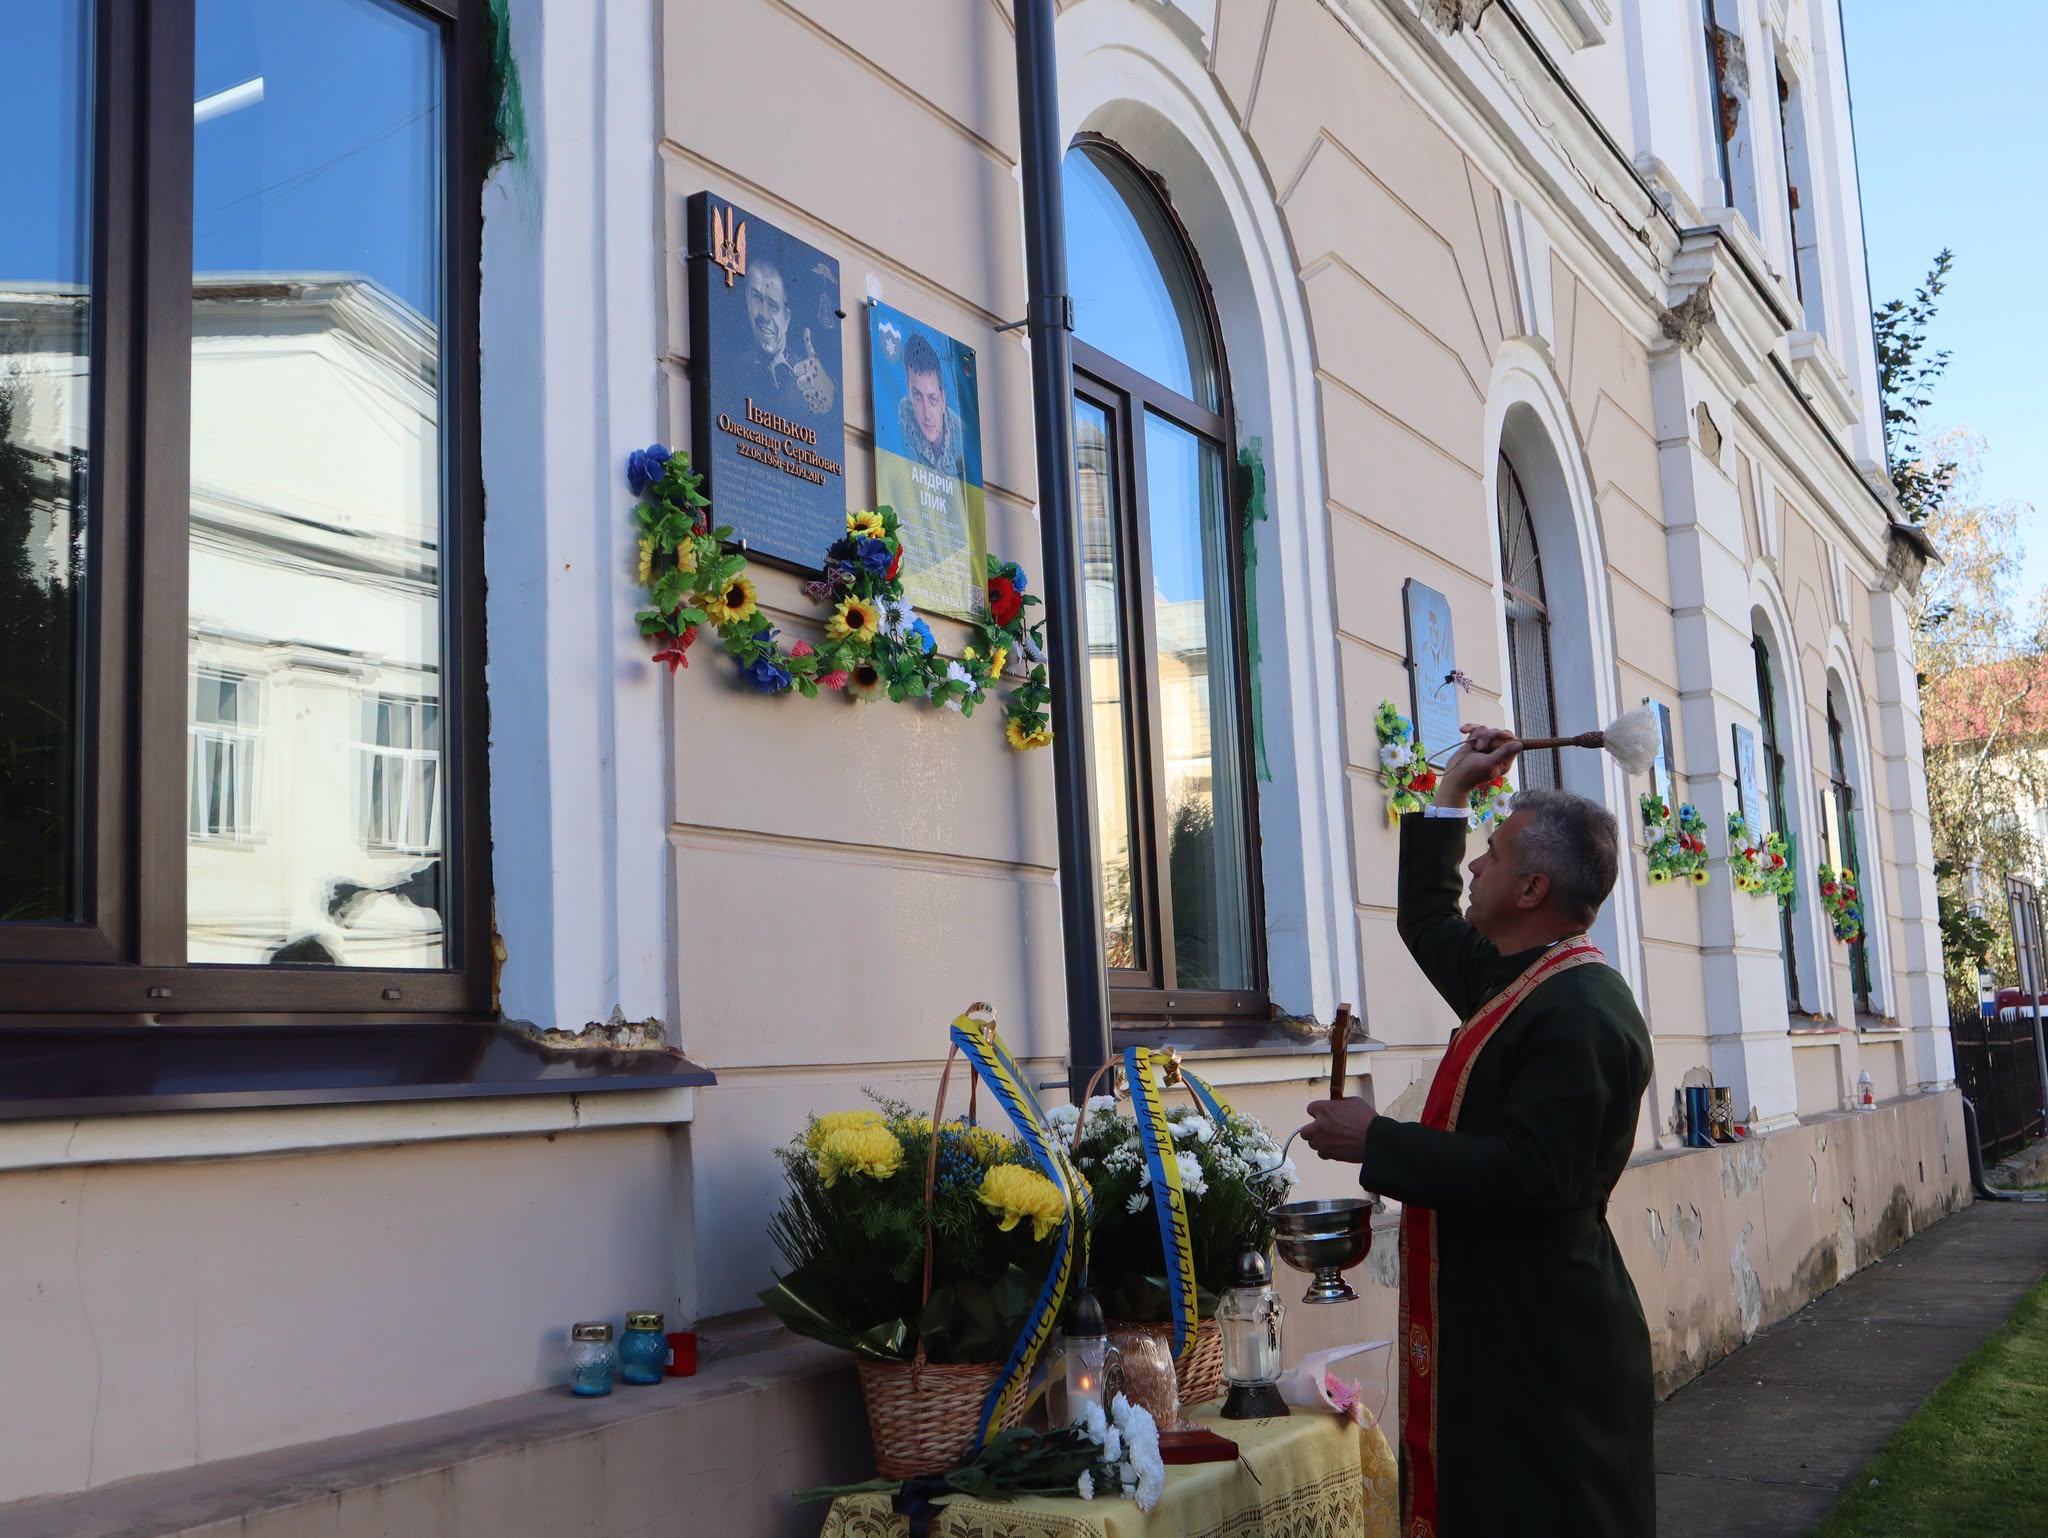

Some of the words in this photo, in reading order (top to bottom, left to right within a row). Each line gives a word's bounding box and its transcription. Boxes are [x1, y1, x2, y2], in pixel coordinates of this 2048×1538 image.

[717, 413, 781, 456] Олександр
[783, 439, 842, 476] Сергійович
[745, 397, 817, 445] Іваньков
[911, 466, 954, 496] АНДРІЙ
[1131, 1057, 1172, 1156] УКРАЇНИ
[1157, 1180, 1196, 1351] ЗАХИСНИКУ
